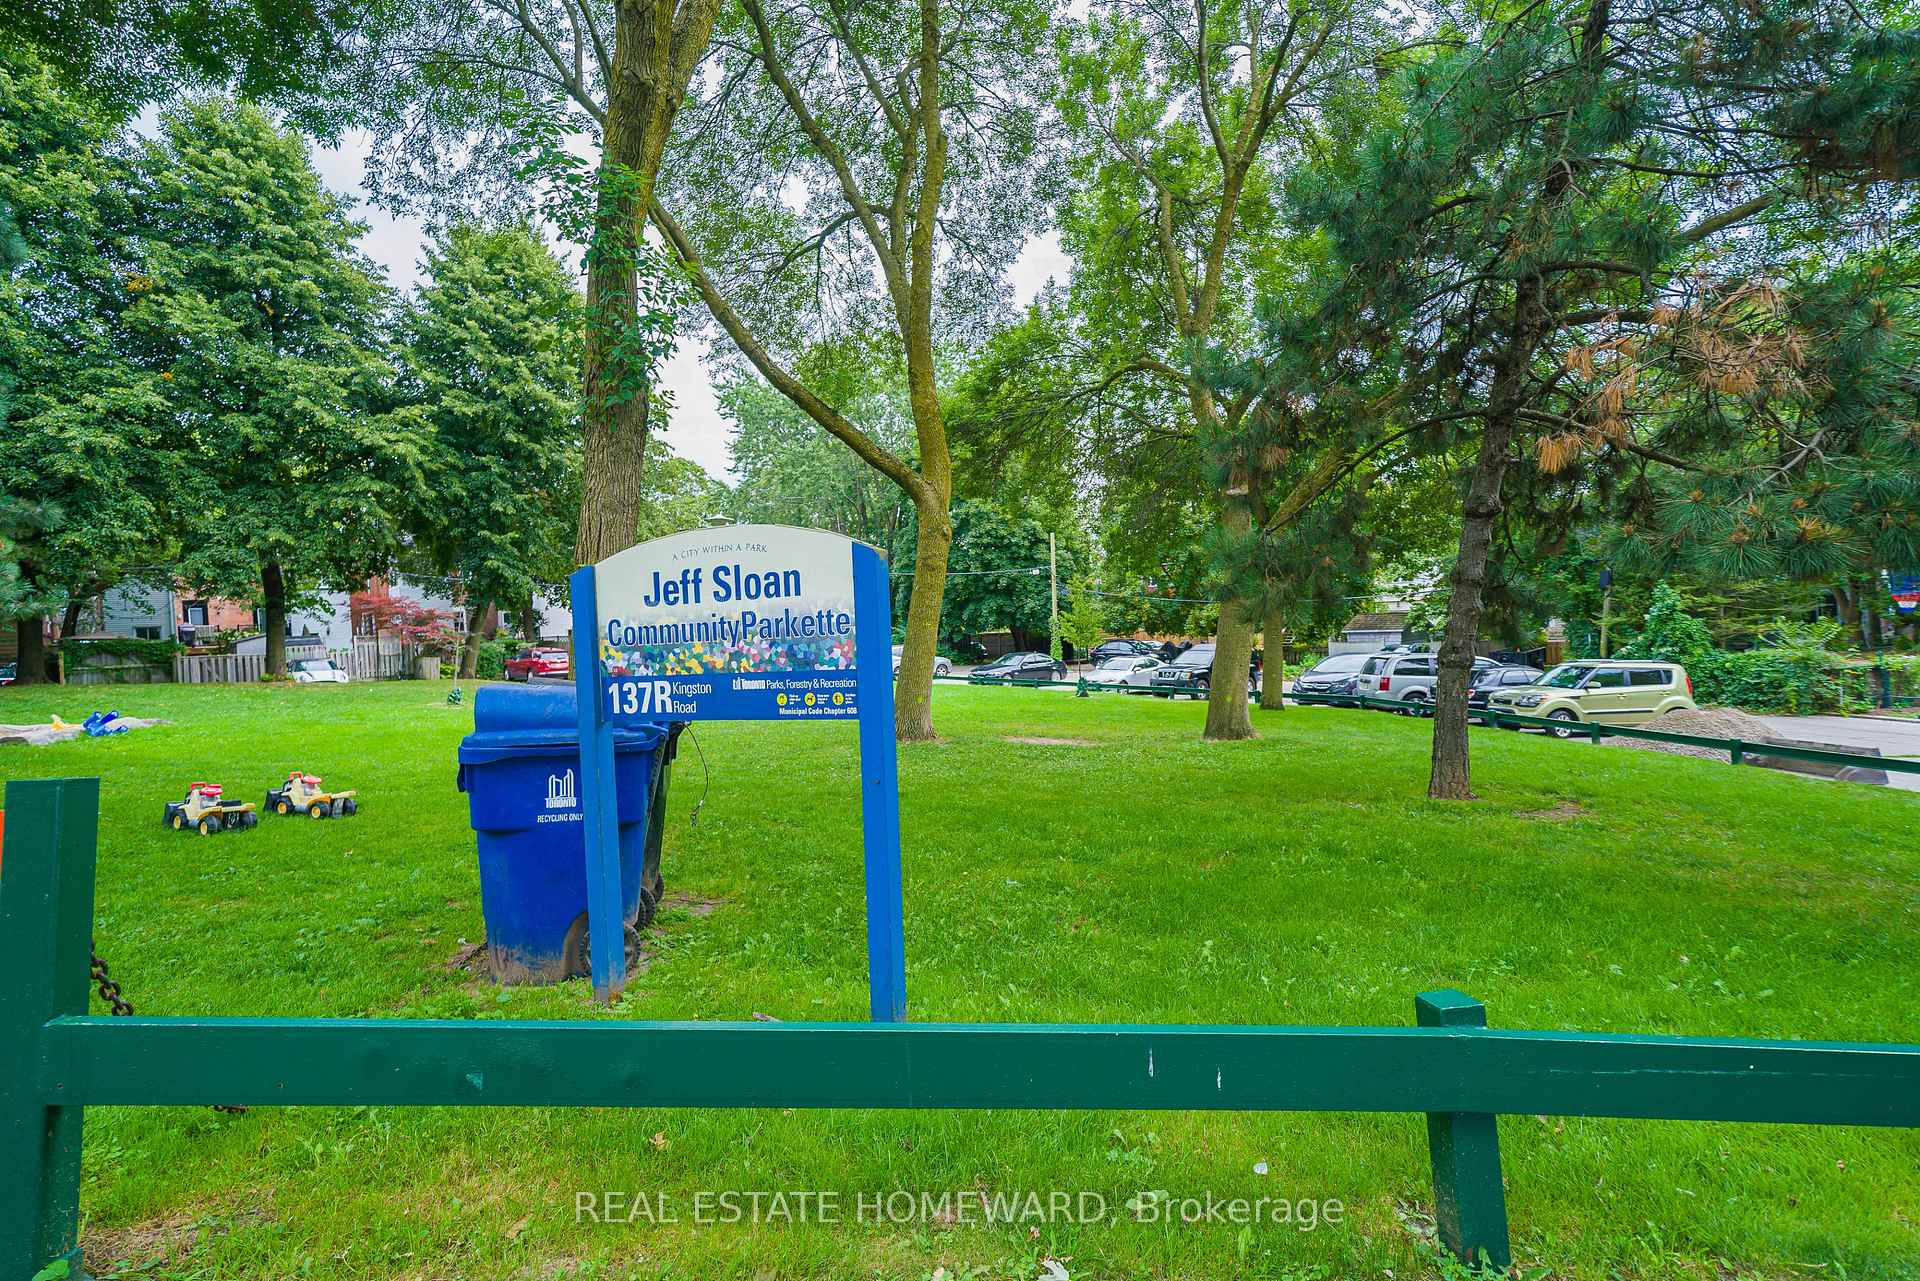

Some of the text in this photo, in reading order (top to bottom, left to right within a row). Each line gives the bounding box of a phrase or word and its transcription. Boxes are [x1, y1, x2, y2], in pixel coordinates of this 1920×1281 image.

[680, 549, 698, 560] CITY
[702, 544, 733, 554] WITHIN
[735, 543, 742, 551] A
[745, 543, 768, 552] PARK
[643, 564, 801, 607] Jeff Sloan
[672, 681, 712, 698] Kingston
[766, 679, 786, 690] Parks,
[786, 679, 812, 691] Forestry
[813, 678, 820, 689] &
[820, 678, 857, 688] Recreation
[608, 680, 673, 714] 137R
[673, 700, 697, 714] Road
[779, 708, 807, 717] Municipal
[823, 707, 846, 716] Chapter
[544, 797, 577, 809] TORONTO
[537, 813, 584, 823] RECYCLING ONLY
